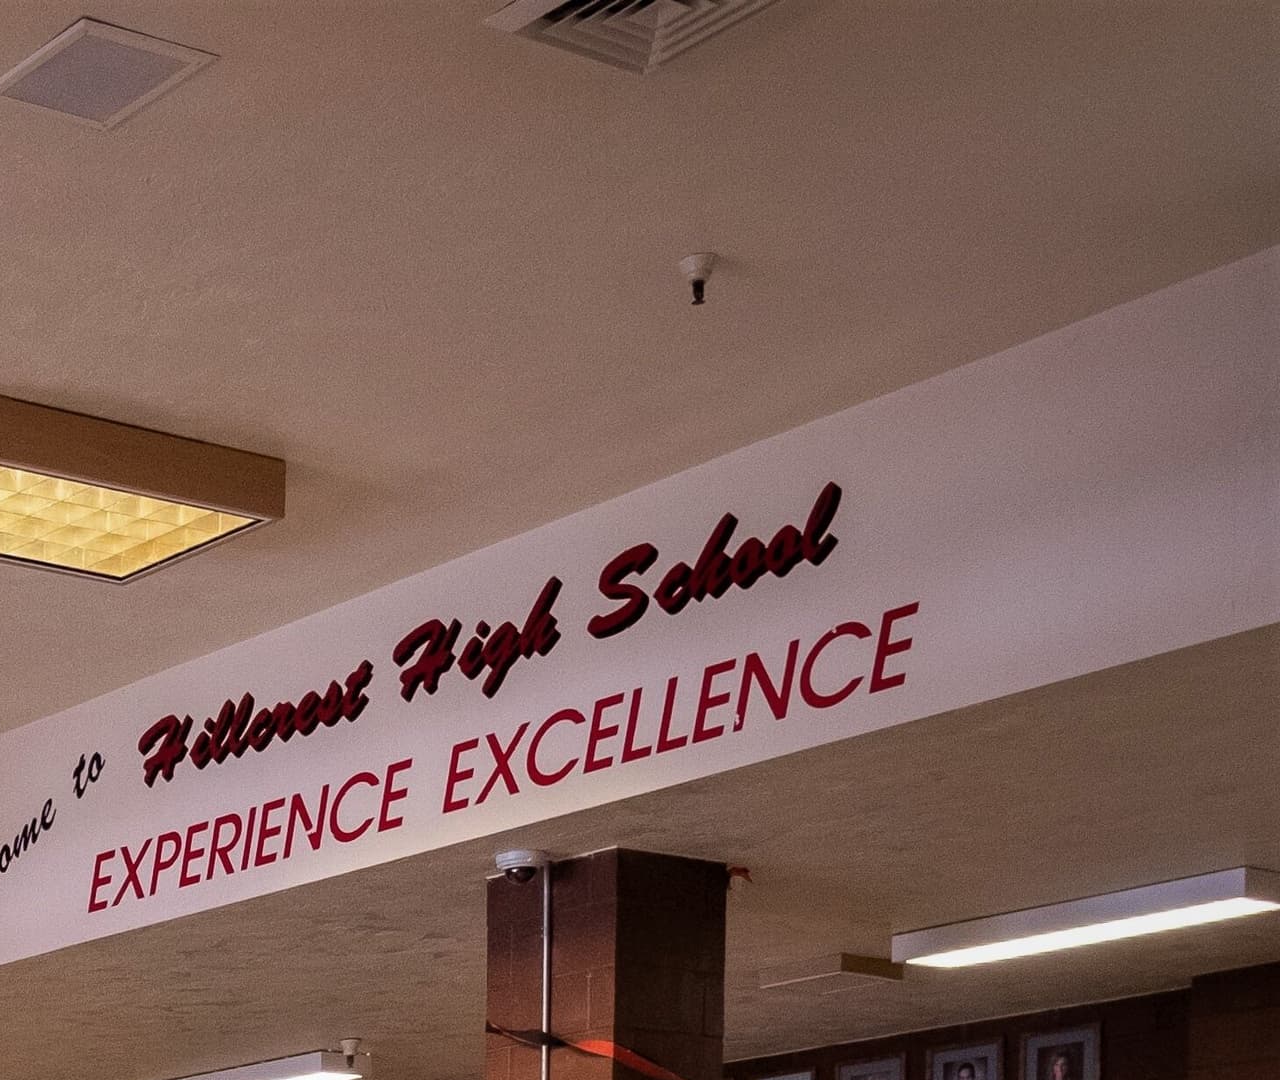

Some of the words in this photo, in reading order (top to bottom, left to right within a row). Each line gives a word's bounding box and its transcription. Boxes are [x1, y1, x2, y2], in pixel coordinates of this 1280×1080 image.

[72, 752, 106, 799] to
[138, 659, 377, 787] Hillcrest
[392, 576, 563, 699] High
[586, 481, 843, 639] School
[87, 759, 414, 914] EXPERIENCE
[442, 602, 921, 814] EXCELLENCE
